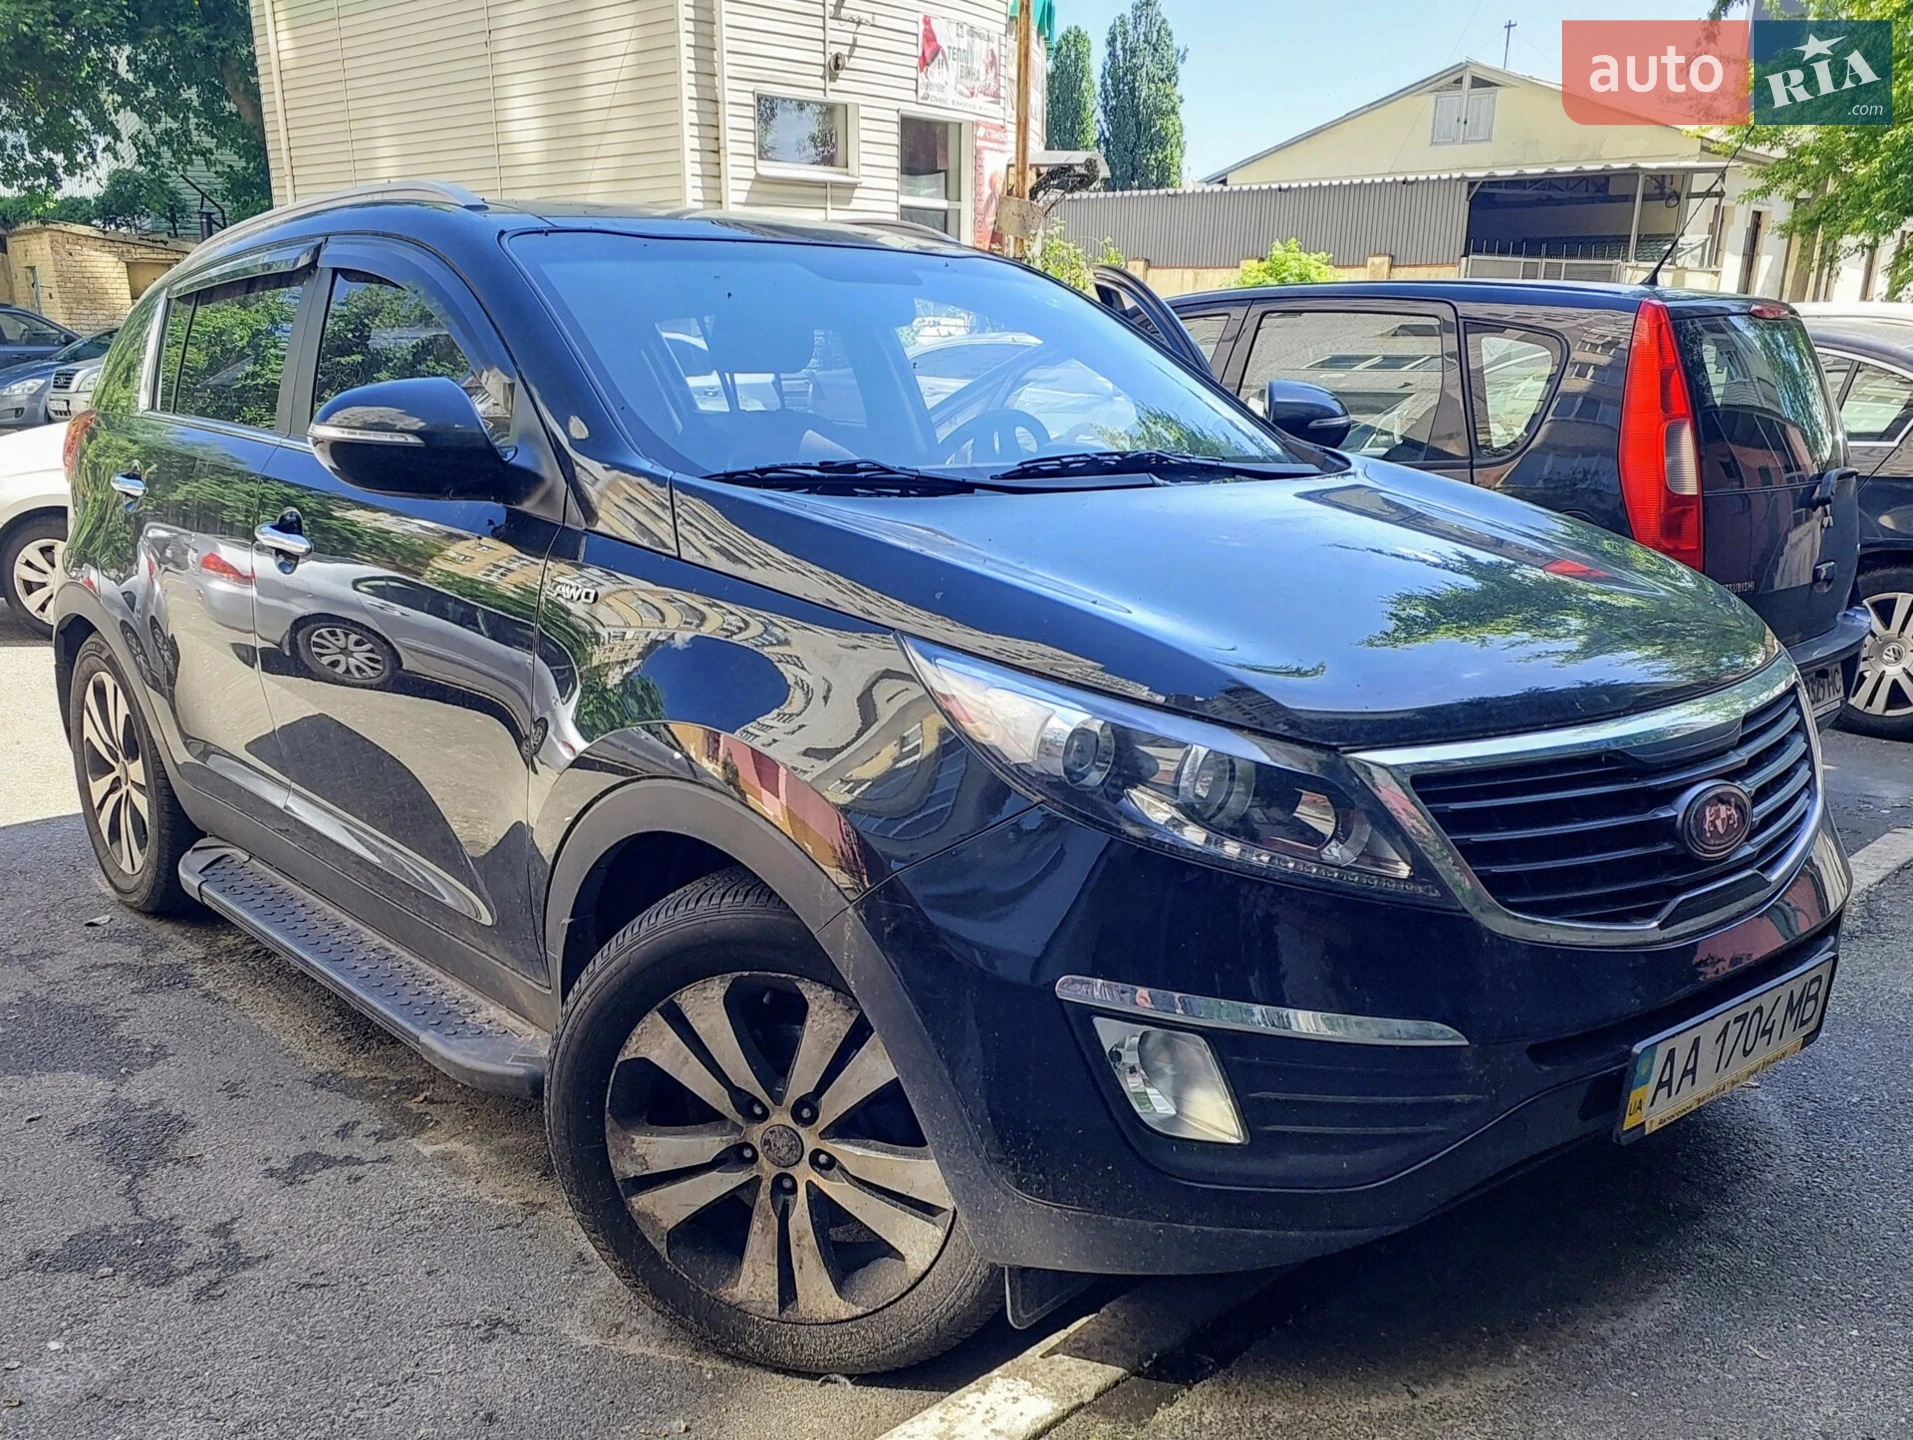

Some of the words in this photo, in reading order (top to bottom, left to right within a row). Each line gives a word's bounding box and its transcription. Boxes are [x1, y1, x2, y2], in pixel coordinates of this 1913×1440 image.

[1649, 1035, 1702, 1108] AA
[1715, 995, 1782, 1074] 1704
[1778, 974, 1824, 1041] MB
[1628, 1098, 1643, 1117] UA
